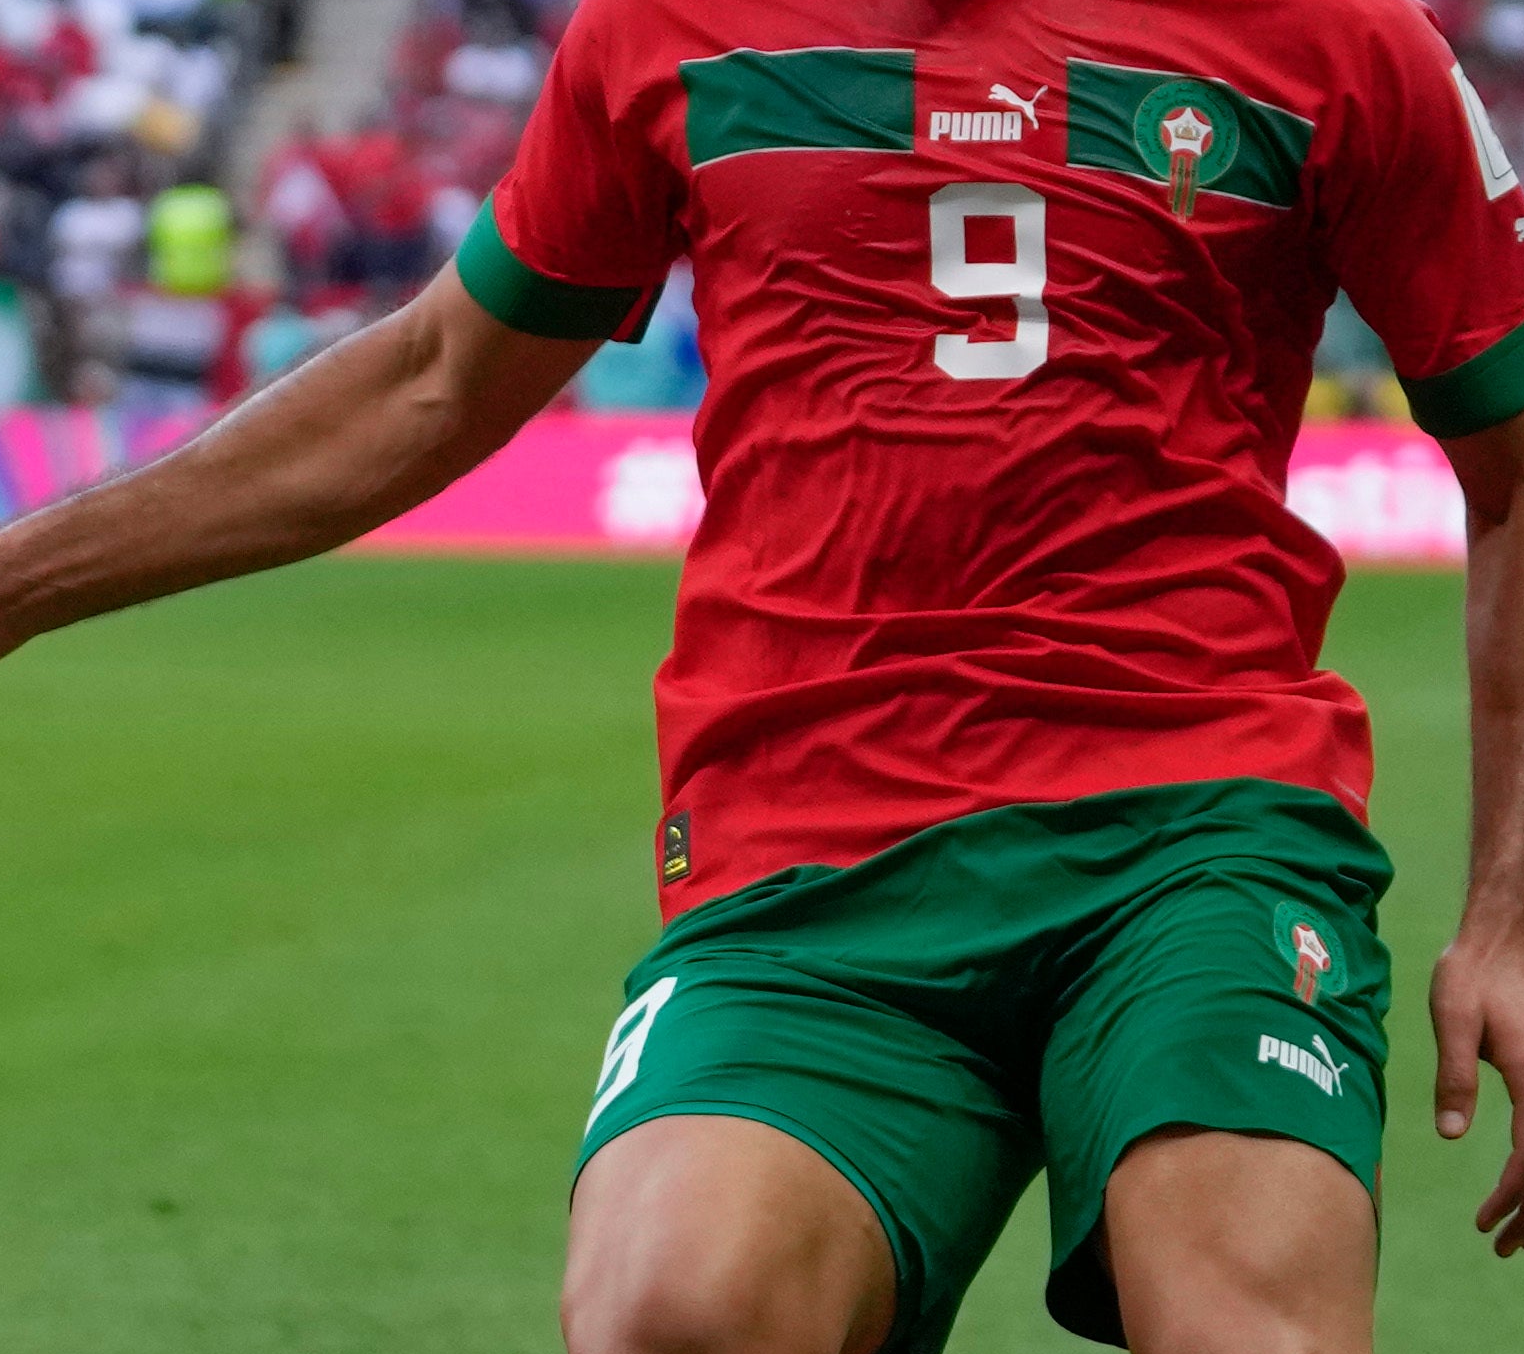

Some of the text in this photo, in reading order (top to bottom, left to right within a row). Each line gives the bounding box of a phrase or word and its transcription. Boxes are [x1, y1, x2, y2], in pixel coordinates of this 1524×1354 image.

[929, 111, 1022, 141] PUMA
[929, 182, 1049, 380] 9
[584, 977, 678, 1140] 9
[1257, 1033, 1334, 1096] PUMA
